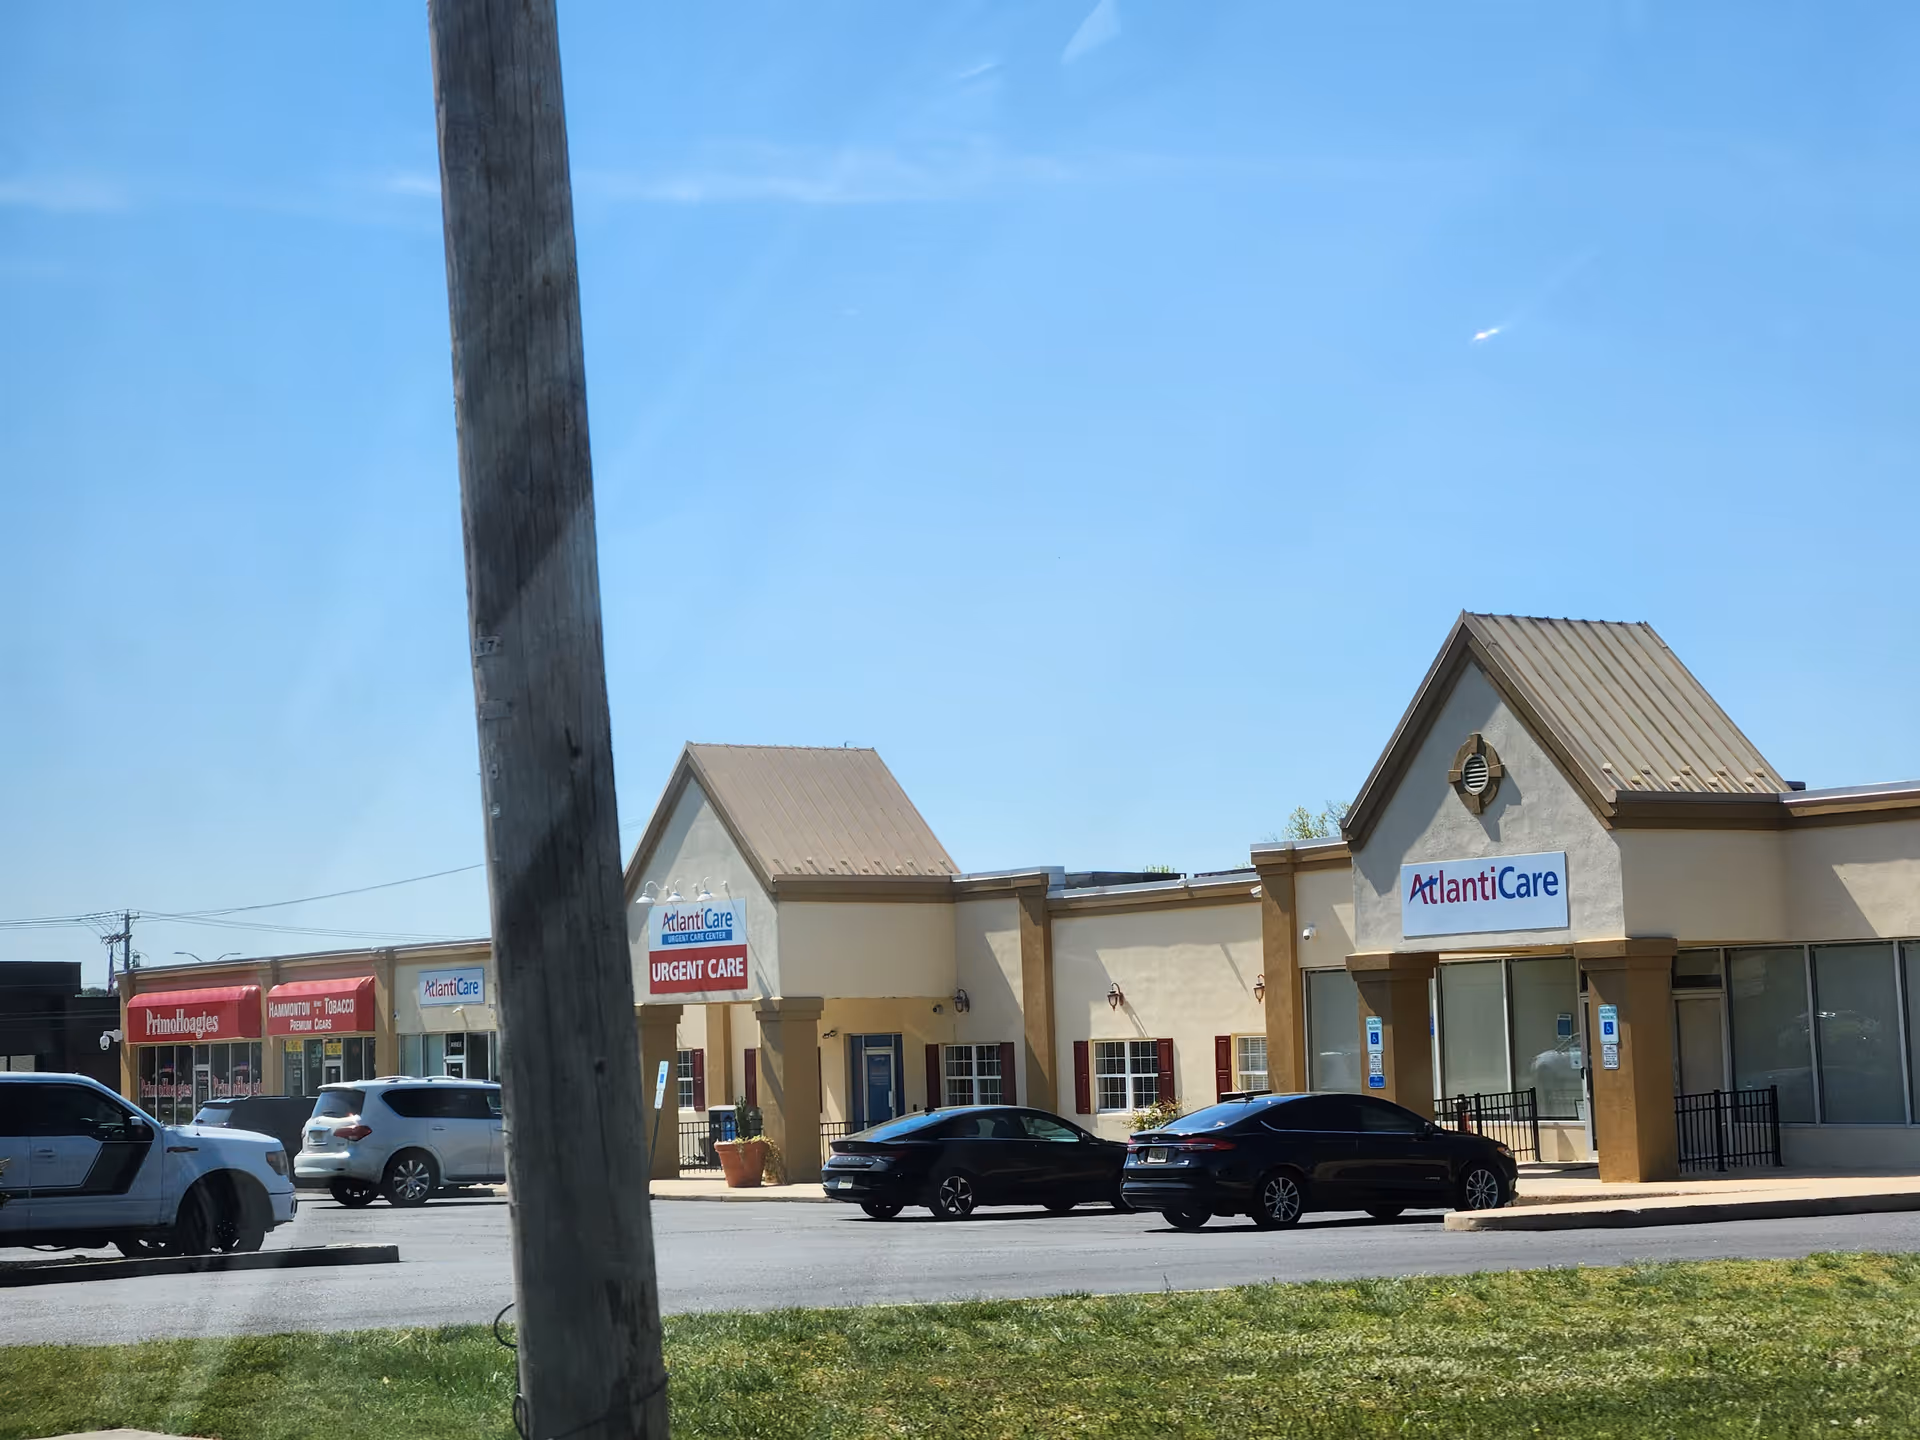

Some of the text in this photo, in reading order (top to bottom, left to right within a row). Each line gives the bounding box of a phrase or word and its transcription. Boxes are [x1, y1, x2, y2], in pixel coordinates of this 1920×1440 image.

[1408, 866, 1559, 905] AtlantiCare
[662, 908, 733, 932] AtlantiCare
[667, 931, 726, 944] URGENT CARE CENTER
[652, 957, 744, 982] URGENT CARE
[424, 977, 479, 998] AtlantiCare
[268, 1001, 311, 1018] HAMMONTON
[324, 997, 355, 1015] TOBACCO
[146, 1008, 219, 1039] PrimoHoagies
[289, 1017, 332, 1031] PREMIUM CIGARS
